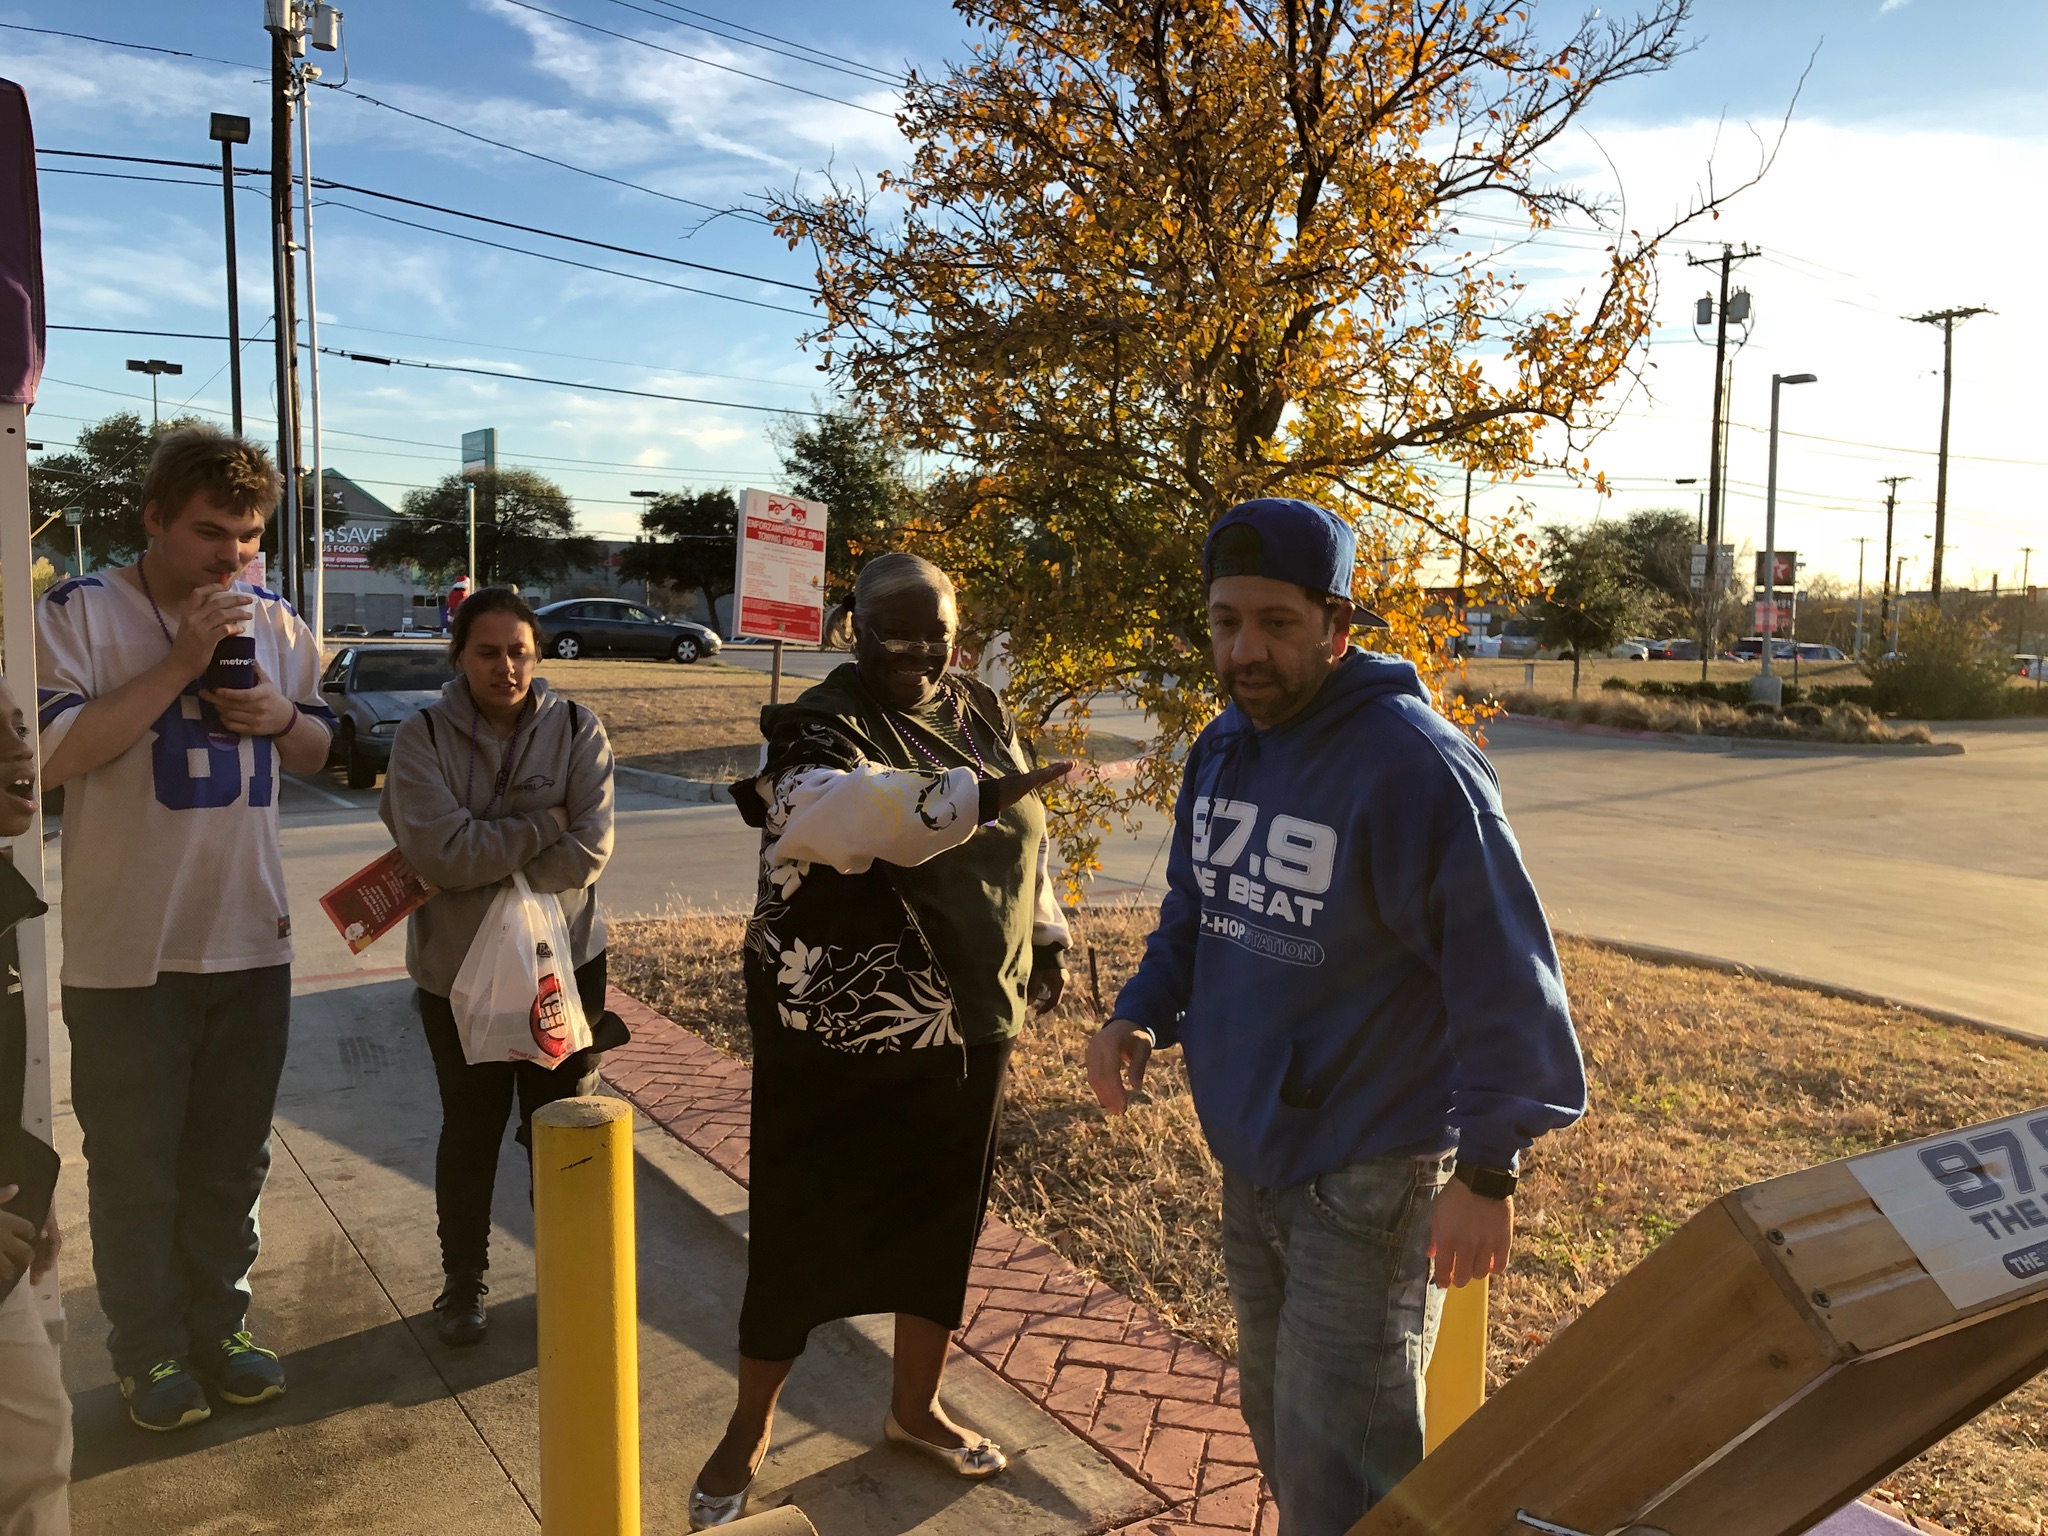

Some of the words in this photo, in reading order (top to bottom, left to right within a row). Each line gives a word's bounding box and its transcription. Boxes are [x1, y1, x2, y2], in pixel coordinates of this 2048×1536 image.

[758, 531, 781, 544] TOWING
[782, 536, 814, 550] ENFORCED
[798, 529, 807, 538] DE
[1228, 873, 1324, 927] BEAT
[1969, 1198, 2048, 1240] THE
[2009, 1251, 2046, 1274] THE
